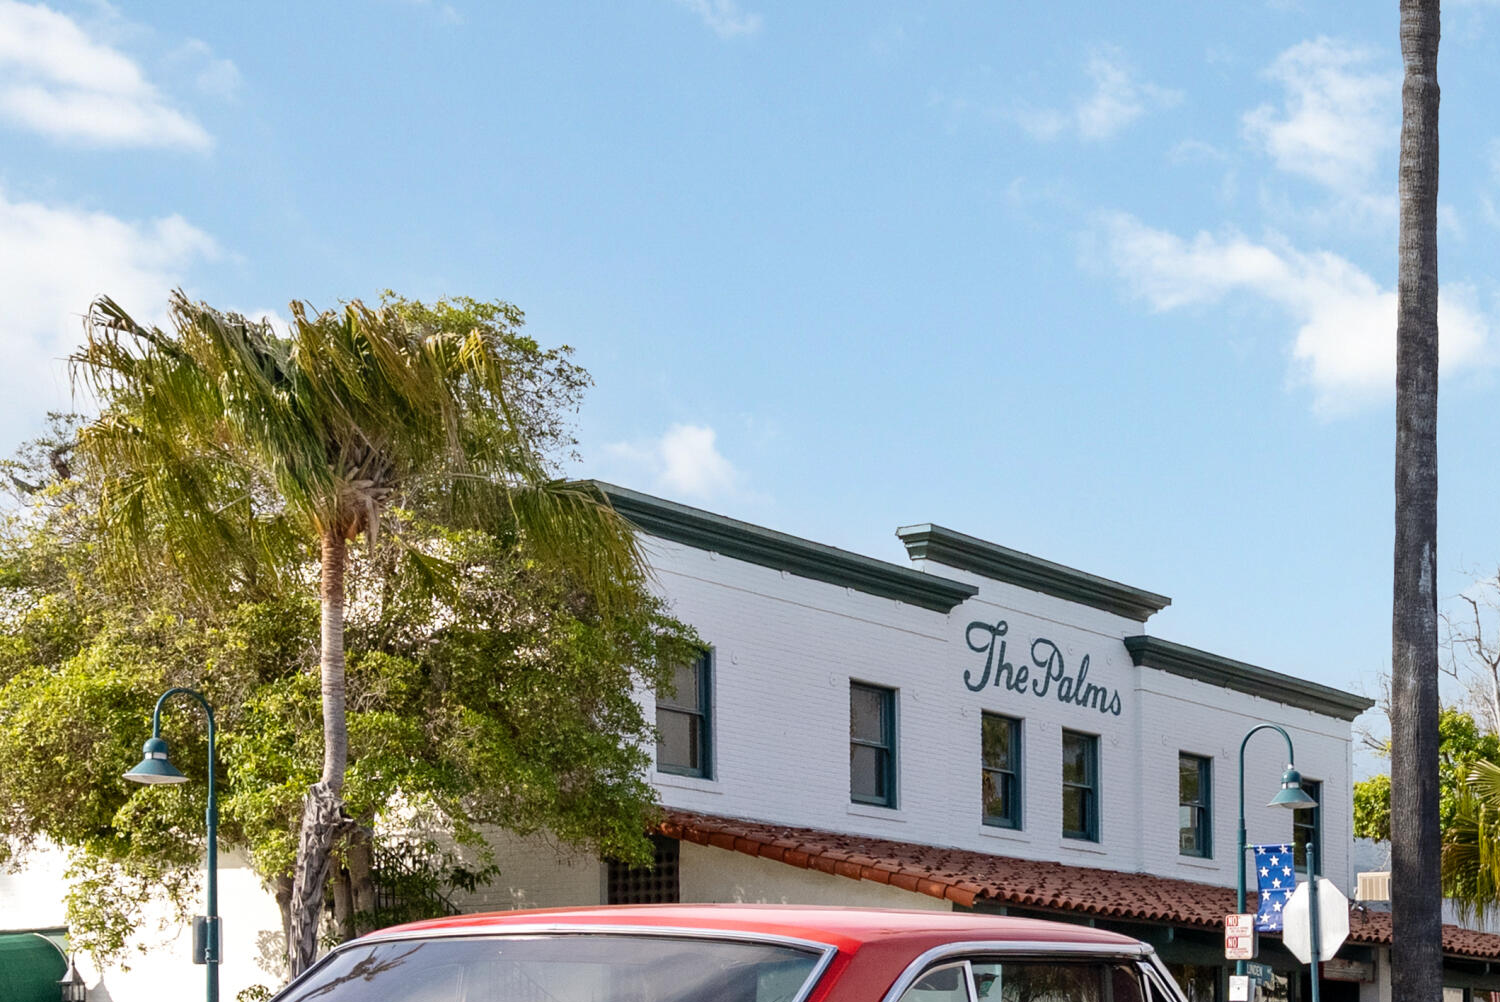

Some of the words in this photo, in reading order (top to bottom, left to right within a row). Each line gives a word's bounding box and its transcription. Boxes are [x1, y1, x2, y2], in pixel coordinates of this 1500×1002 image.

[963, 620, 1029, 694] The
[1031, 637, 1122, 716] Palms
[1228, 916, 1239, 926] NO
[1228, 937, 1239, 948] NO
